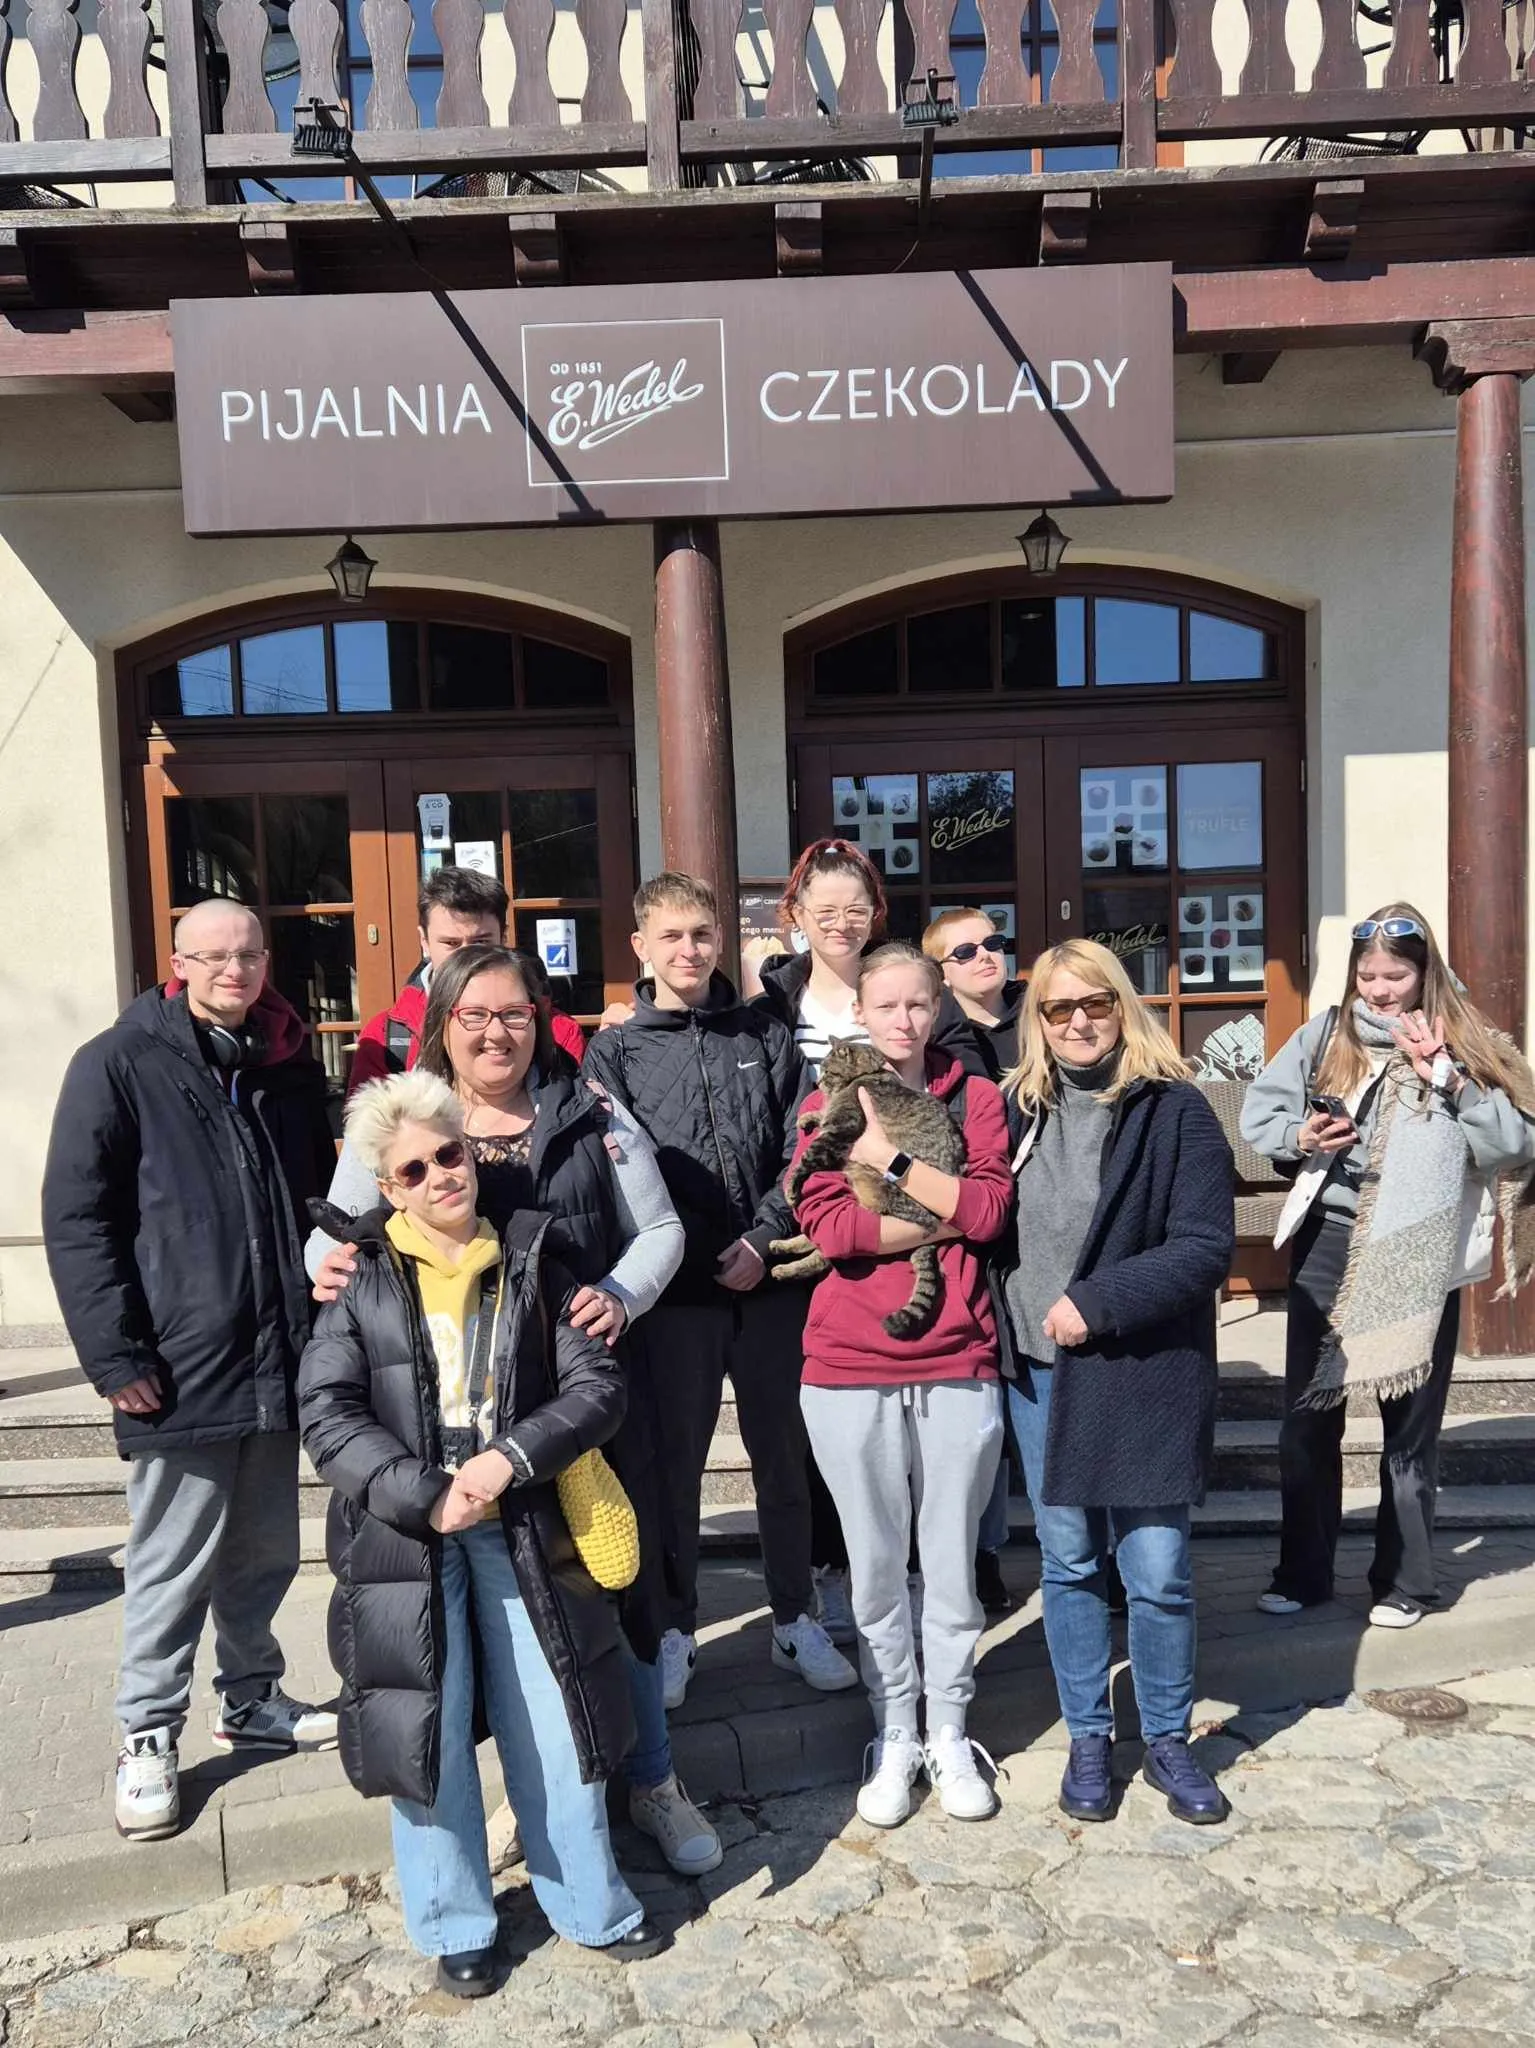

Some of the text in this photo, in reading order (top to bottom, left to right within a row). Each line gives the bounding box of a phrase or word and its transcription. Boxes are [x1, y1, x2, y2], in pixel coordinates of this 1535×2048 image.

[550, 361, 601, 375] OD 1851
[759, 356, 1129, 423] CZEKOLADY
[220, 382, 492, 442] PIJALNIA
